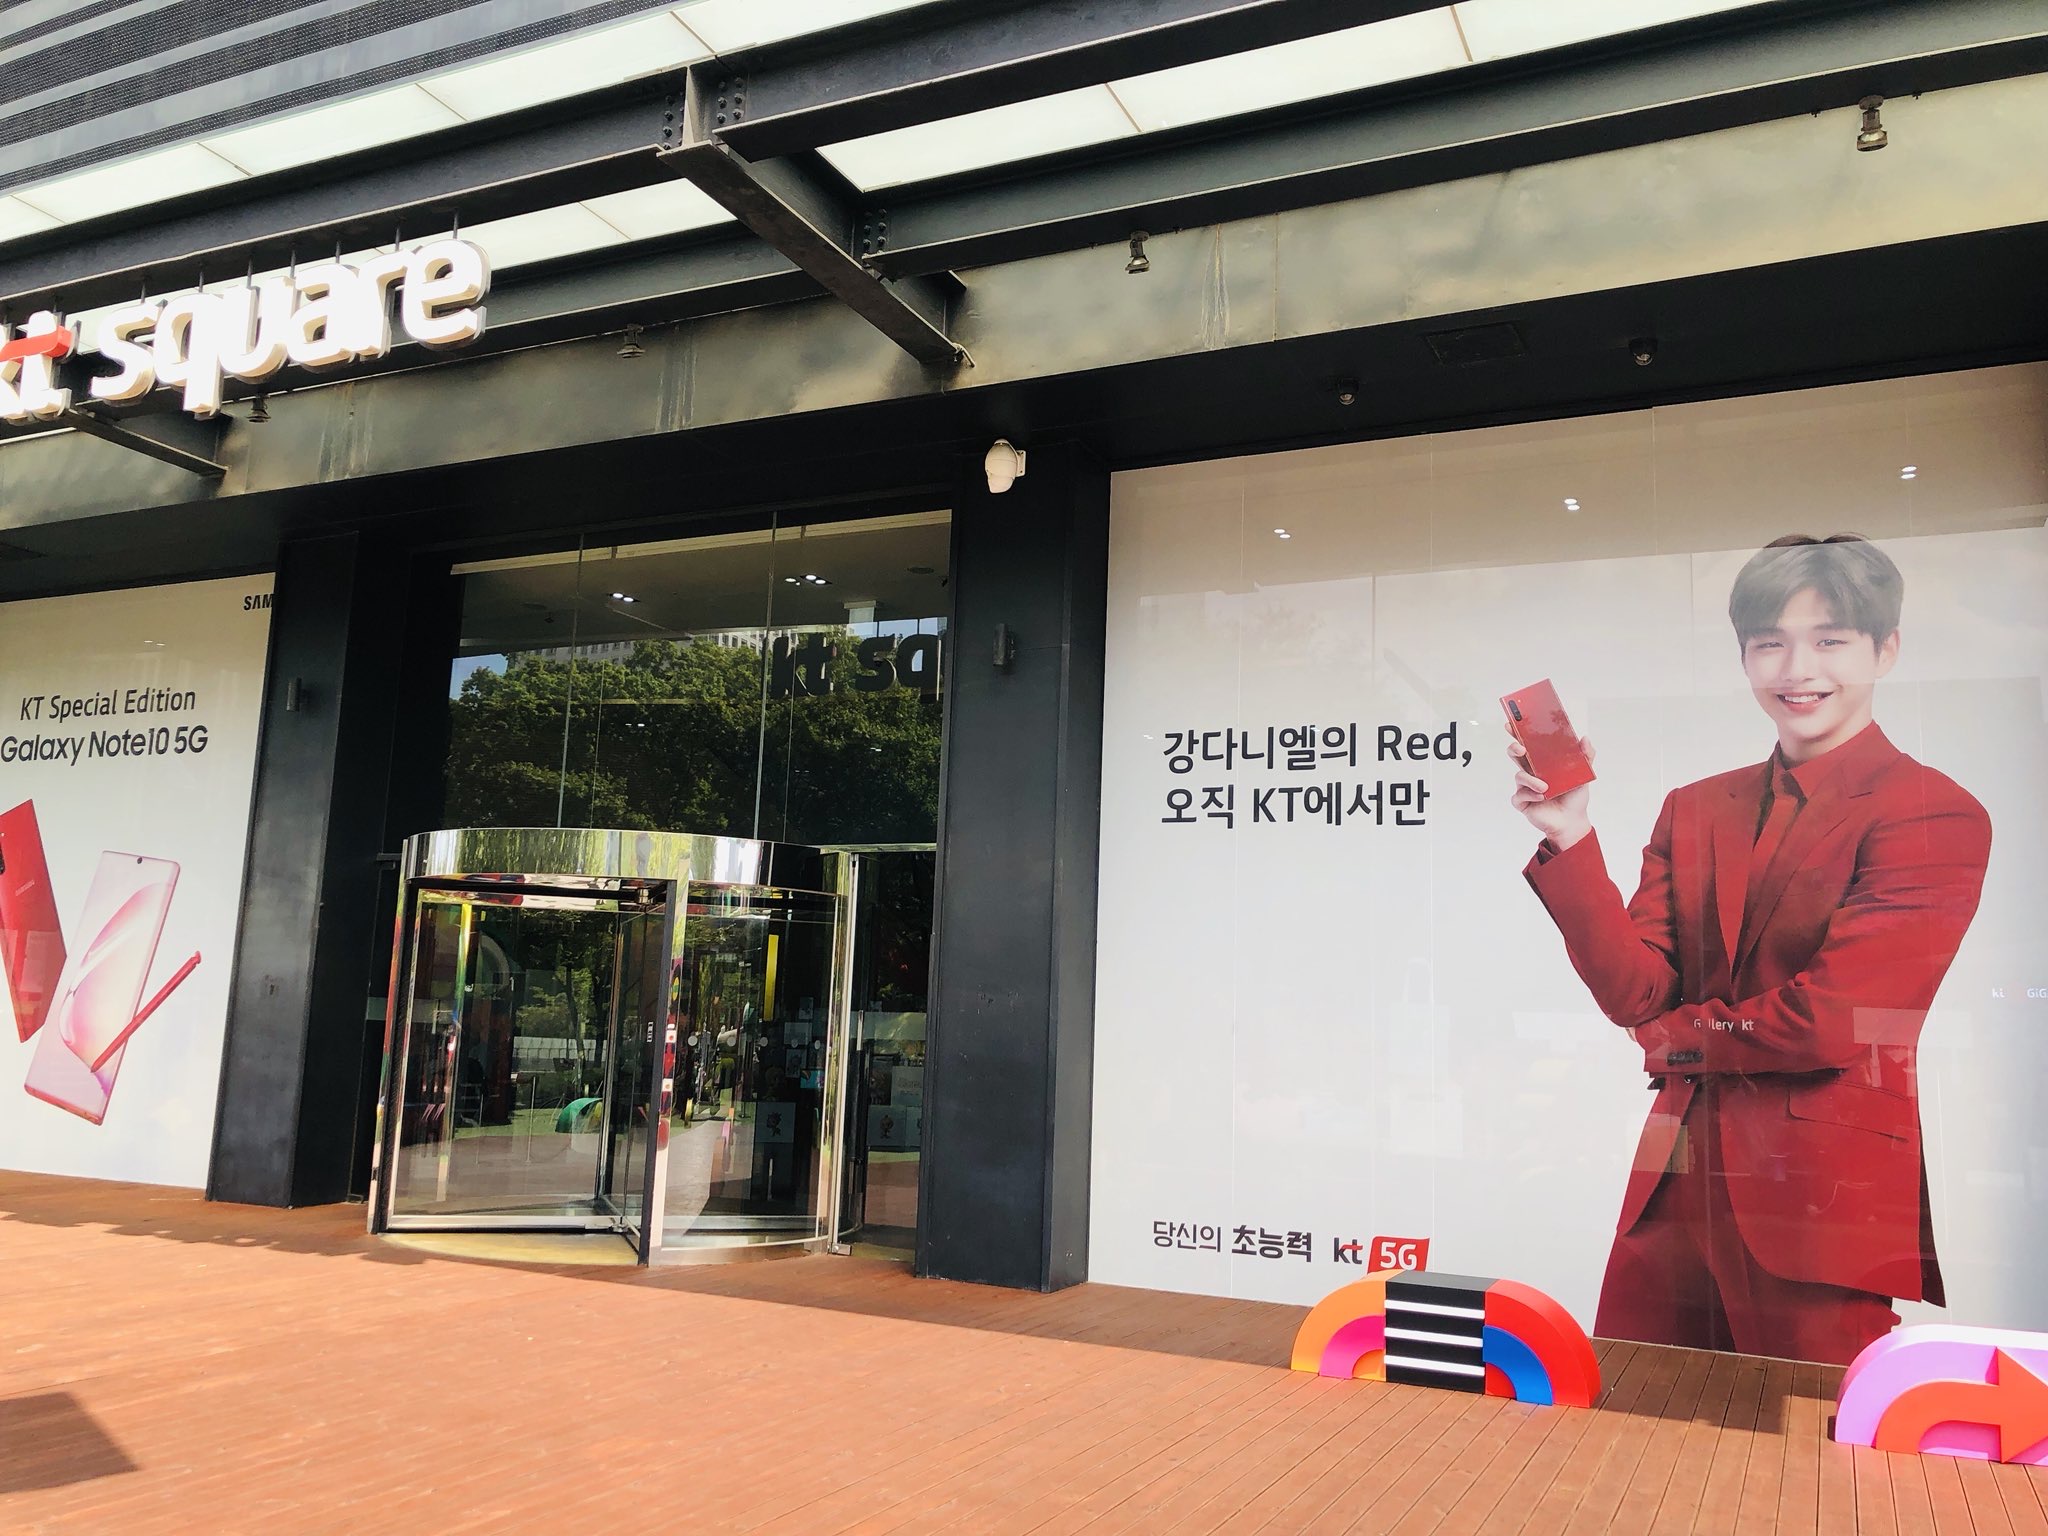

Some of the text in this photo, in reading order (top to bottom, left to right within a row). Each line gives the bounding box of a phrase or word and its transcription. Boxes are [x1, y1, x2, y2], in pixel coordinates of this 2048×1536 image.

[90, 238, 490, 419] square
[20, 687, 196, 724] KT Special Edition
[1, 725, 209, 767] Galaxy Note10 5G
[1163, 721, 1472, 774] 강다니엘의 Red,
[1161, 779, 1430, 829] 오직 KT에서만
[1153, 1220, 1417, 1271] 당신의 초능력 kt 5G
